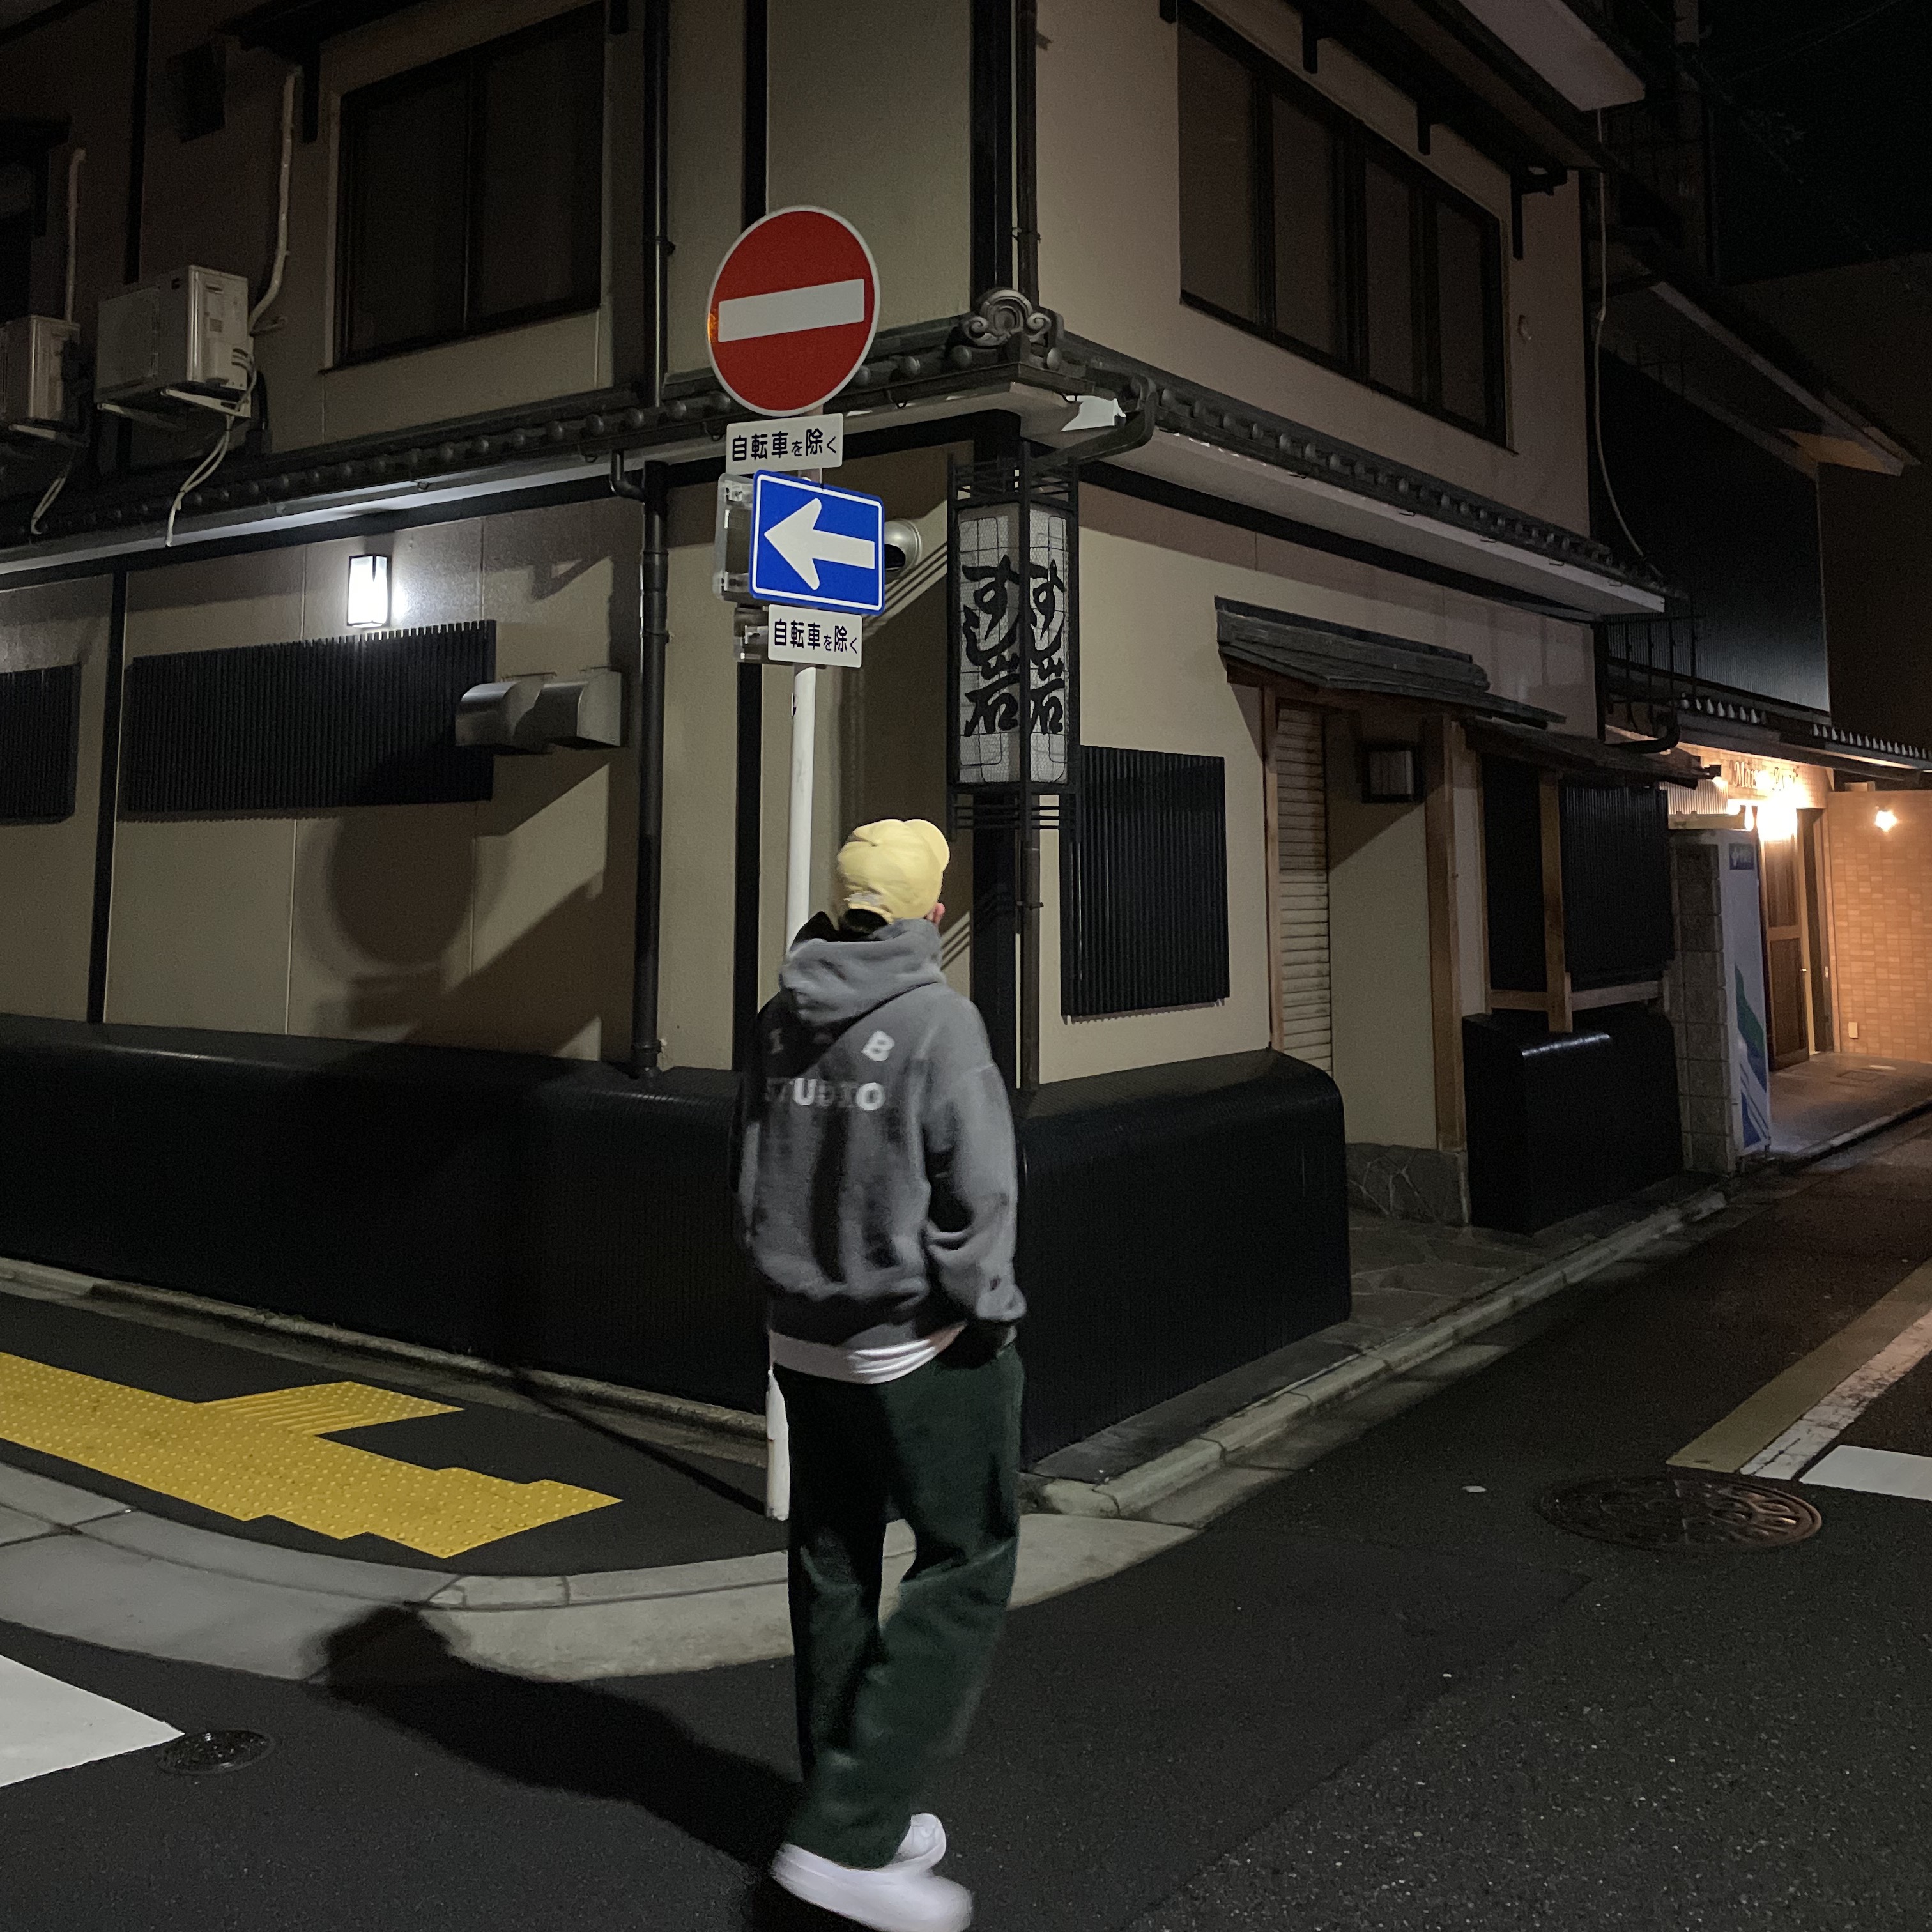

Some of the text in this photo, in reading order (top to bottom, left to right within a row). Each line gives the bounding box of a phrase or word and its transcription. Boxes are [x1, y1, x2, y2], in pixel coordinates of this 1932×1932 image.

[732, 429, 836, 461] 自転車を除く
[774, 618, 858, 654] 自転車を除く
